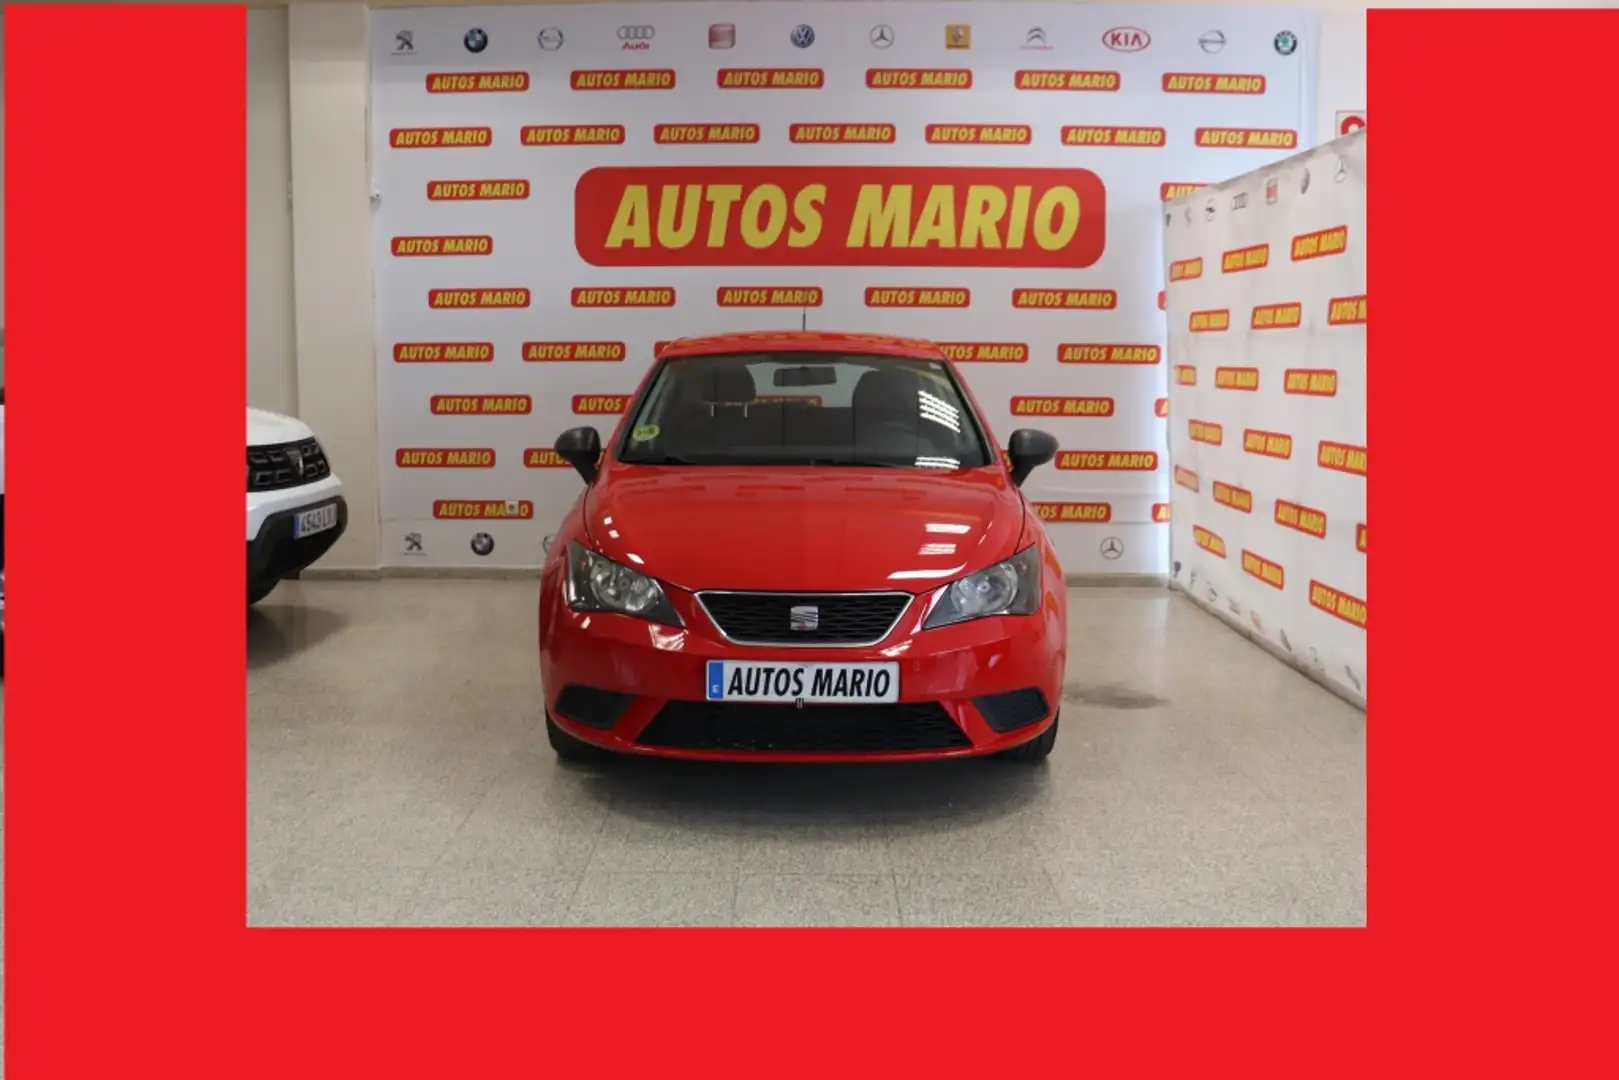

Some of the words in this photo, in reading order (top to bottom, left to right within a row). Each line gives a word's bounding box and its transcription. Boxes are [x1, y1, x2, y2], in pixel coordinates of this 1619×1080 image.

[1111, 33, 1141, 47] KIA
[432, 76, 475, 90] AUTOS
[479, 75, 525, 90] MARIO
[576, 73, 620, 86] AUTOS
[624, 73, 671, 86] MARIO
[723, 71, 768, 86] AUTOS
[772, 70, 820, 86] MARIO
[872, 71, 917, 85] AUTOS
[921, 71, 968, 86] MARIO
[1022, 74, 1066, 86] AUTOS
[1070, 74, 1117, 87] MARIO
[1168, 76, 1212, 90] AUTOS
[1215, 77, 1262, 91] MARIO
[395, 131, 438, 146] AUTOS
[442, 130, 488, 144] MARIO
[526, 129, 569, 142] AUTOS
[573, 128, 620, 142] MARIO
[660, 126, 704, 140] AUTOS
[708, 126, 755, 140] MARIO
[796, 126, 840, 140] AUTOS
[844, 126, 891, 140] MARIO
[932, 127, 976, 140] AUTOS
[980, 127, 1027, 141] MARIO
[1067, 129, 1111, 143] AUTOS
[1115, 129, 1162, 143] MARIO
[1201, 130, 1244, 145] AUTOS
[1248, 132, 1294, 146] MARIO
[433, 183, 476, 197] AUTOS
[480, 183, 526, 196] MARIO
[604, 185, 827, 248] AUTOS
[846, 185, 1081, 250] MARIO
[397, 238, 439, 254] AUTOS
[443, 238, 488, 253] MARIO
[434, 291, 477, 306] AUTOS
[480, 291, 526, 306] MARIO
[578, 290, 621, 305] AUTOS
[625, 289, 672, 304] MARIO
[724, 291, 768, 304] AUTOS
[772, 290, 819, 304] MARIO
[871, 291, 915, 304] AUTOS
[919, 291, 967, 306] MARIO
[1018, 292, 1062, 306] AUTOS
[1066, 292, 1114, 307] MARIO
[399, 346, 441, 358] AUTOS
[445, 346, 490, 359] MARIO
[528, 346, 571, 358] AUTOS
[575, 345, 622, 358] MARIO
[977, 344, 1024, 360] MARIO
[1064, 347, 1107, 362] AUTOS
[1111, 348, 1157, 362] MARIO
[436, 397, 478, 412] AUTOS
[482, 398, 526, 412] MARIO
[578, 398, 621, 411] AUTOS
[1016, 399, 1059, 412] AUTOS
[1063, 399, 1109, 414] MARIO
[402, 452, 443, 465] AUTOS
[447, 452, 491, 465] MARIO
[1061, 453, 1104, 468] AUTOS
[1108, 453, 1154, 468] MARIO
[439, 503, 480, 516] AUTOS
[484, 503, 529, 516] MAO
[1061, 505, 1107, 519] MARIO
[727, 667, 804, 697] AUTOS
[811, 668, 890, 697] MARIO
